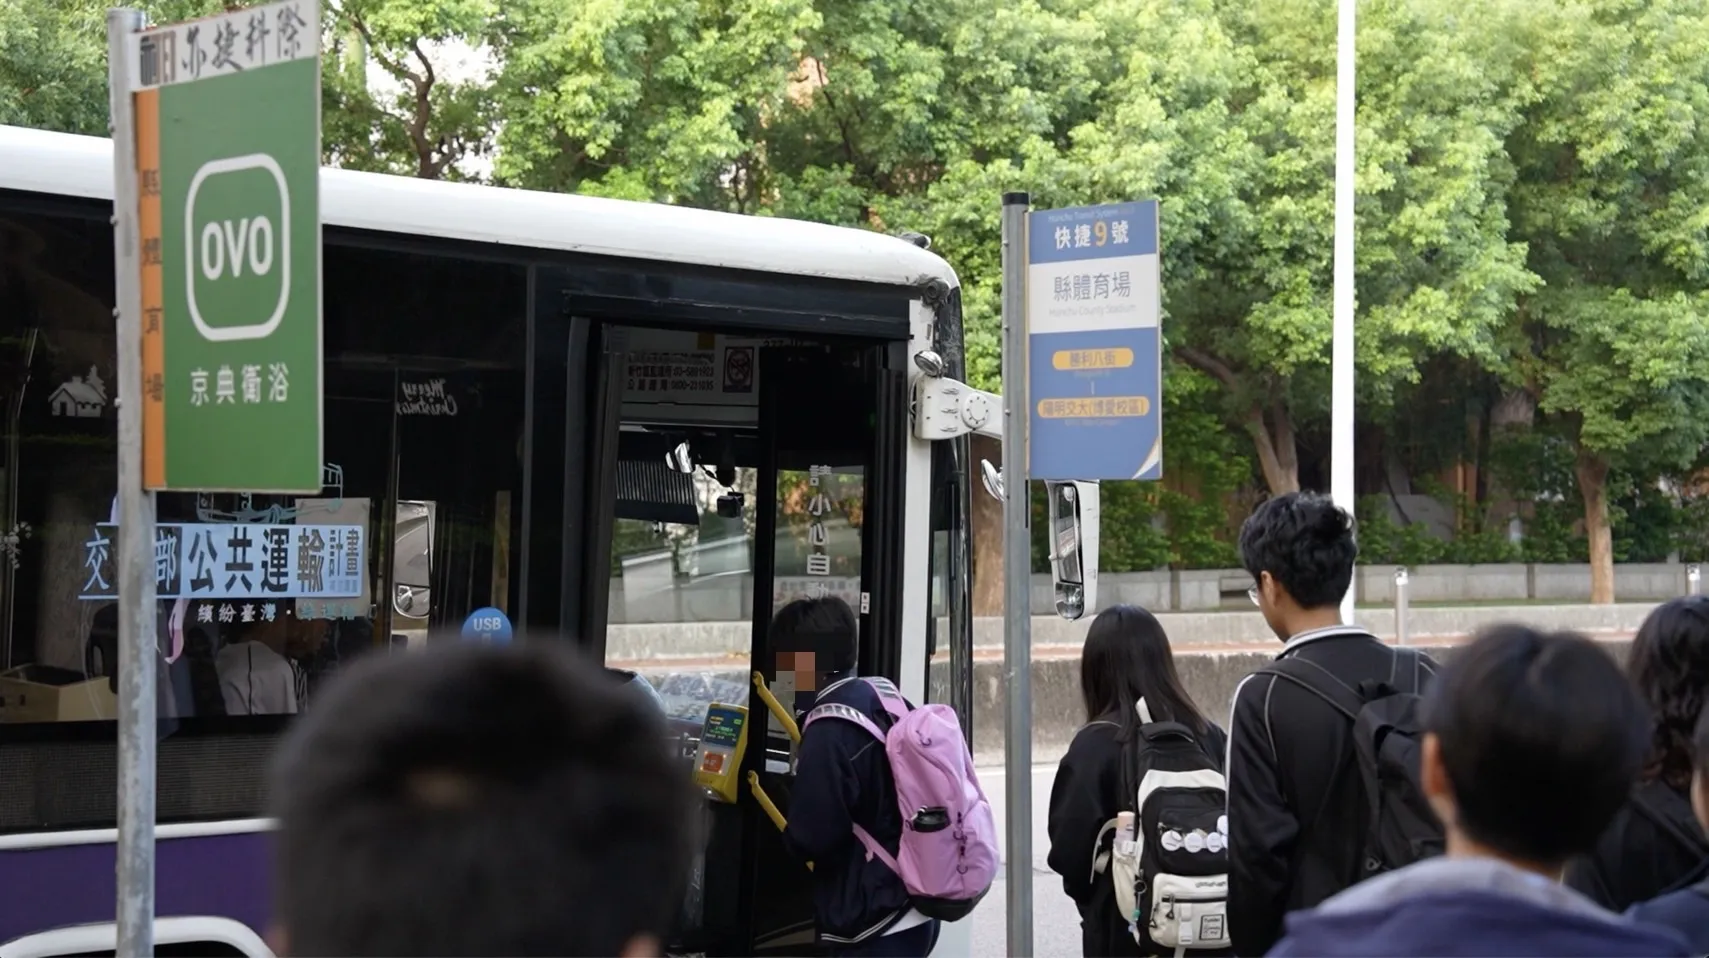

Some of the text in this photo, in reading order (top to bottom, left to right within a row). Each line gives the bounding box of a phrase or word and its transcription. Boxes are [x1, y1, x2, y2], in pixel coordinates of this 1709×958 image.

[201, 215, 274, 281] OVO
[1055, 219, 1129, 250] 快捷9號
[1053, 271, 1132, 302] 縣體育場
[190, 362, 290, 407] 京典衛浴
[83, 527, 361, 593] 交部公共運輸計畫
[473, 616, 502, 632] USB
